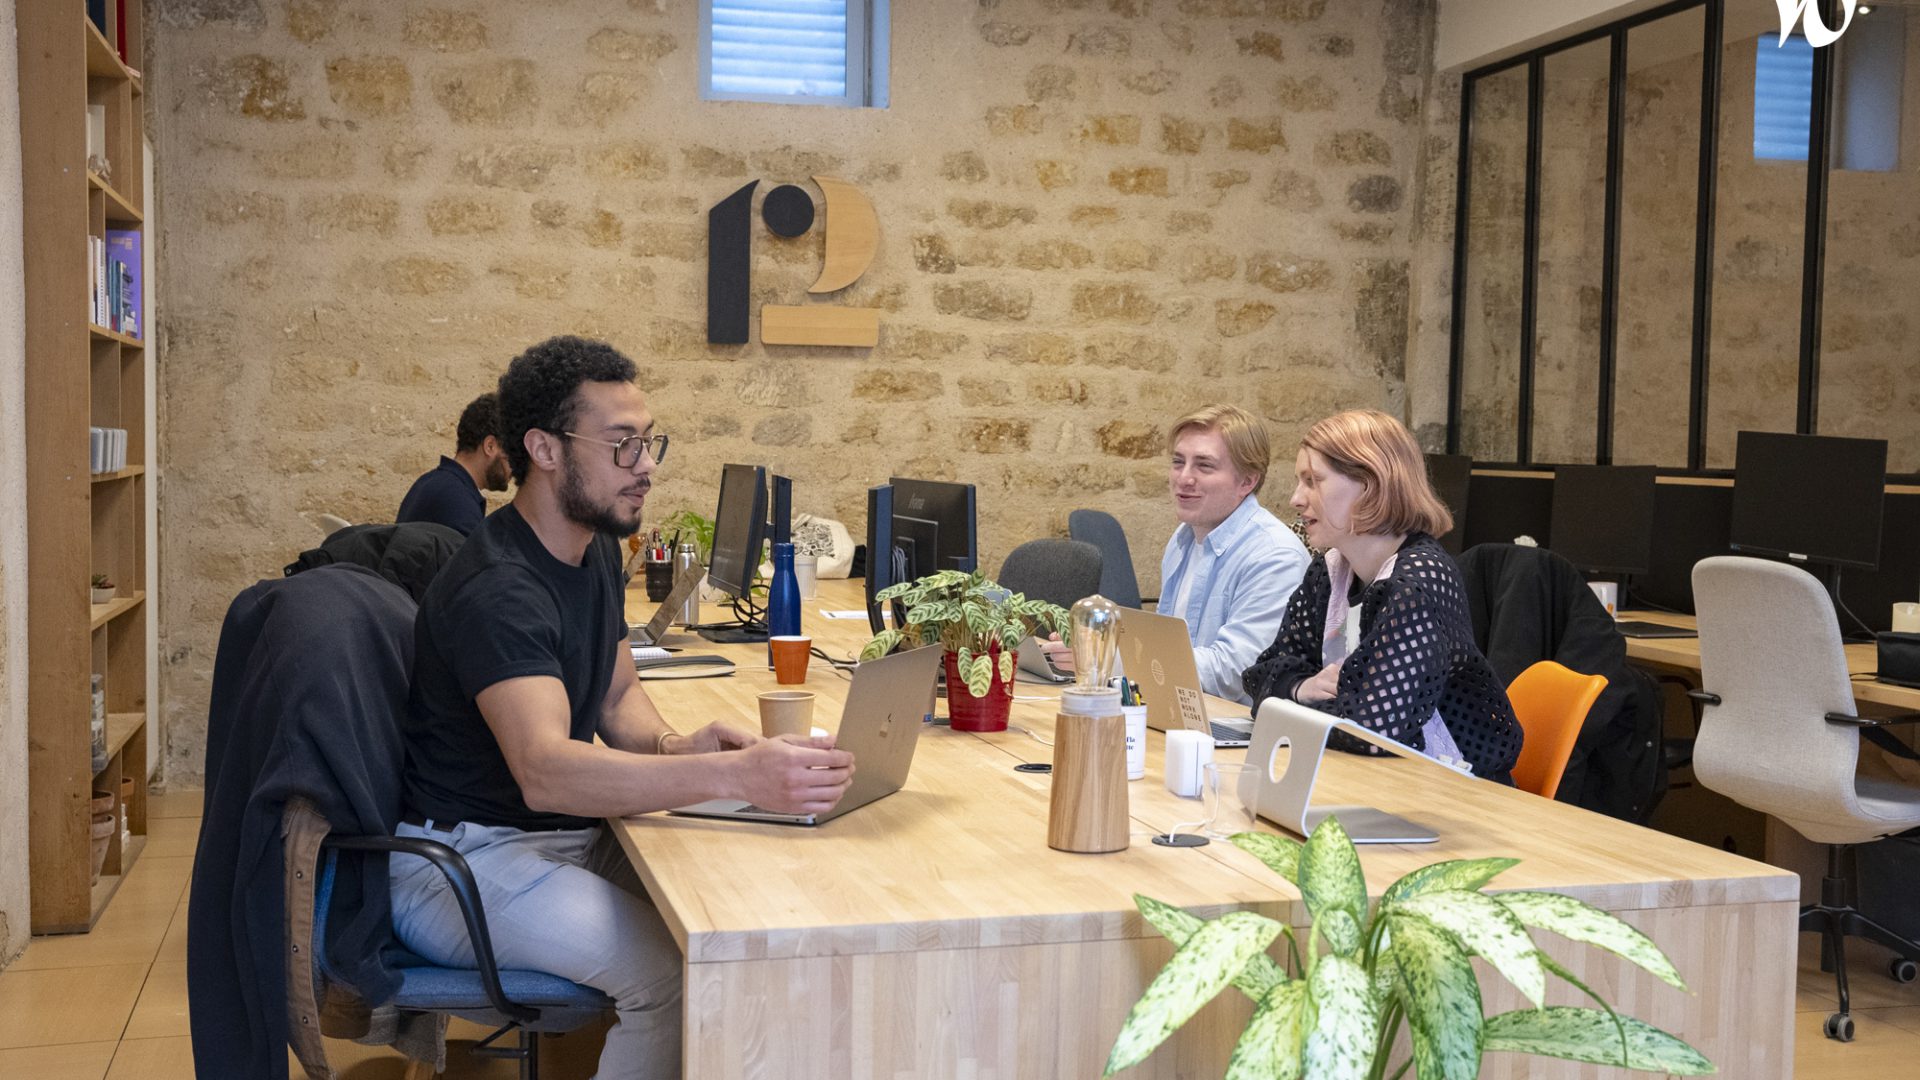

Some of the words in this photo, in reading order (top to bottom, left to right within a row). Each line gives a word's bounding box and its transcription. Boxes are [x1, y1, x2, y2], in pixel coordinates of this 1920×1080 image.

[1178, 688, 1185, 696] WE
[1180, 696, 1190, 704] NOT
[1181, 703, 1196, 712] WORK
[1183, 711, 1202, 722] ALONE
